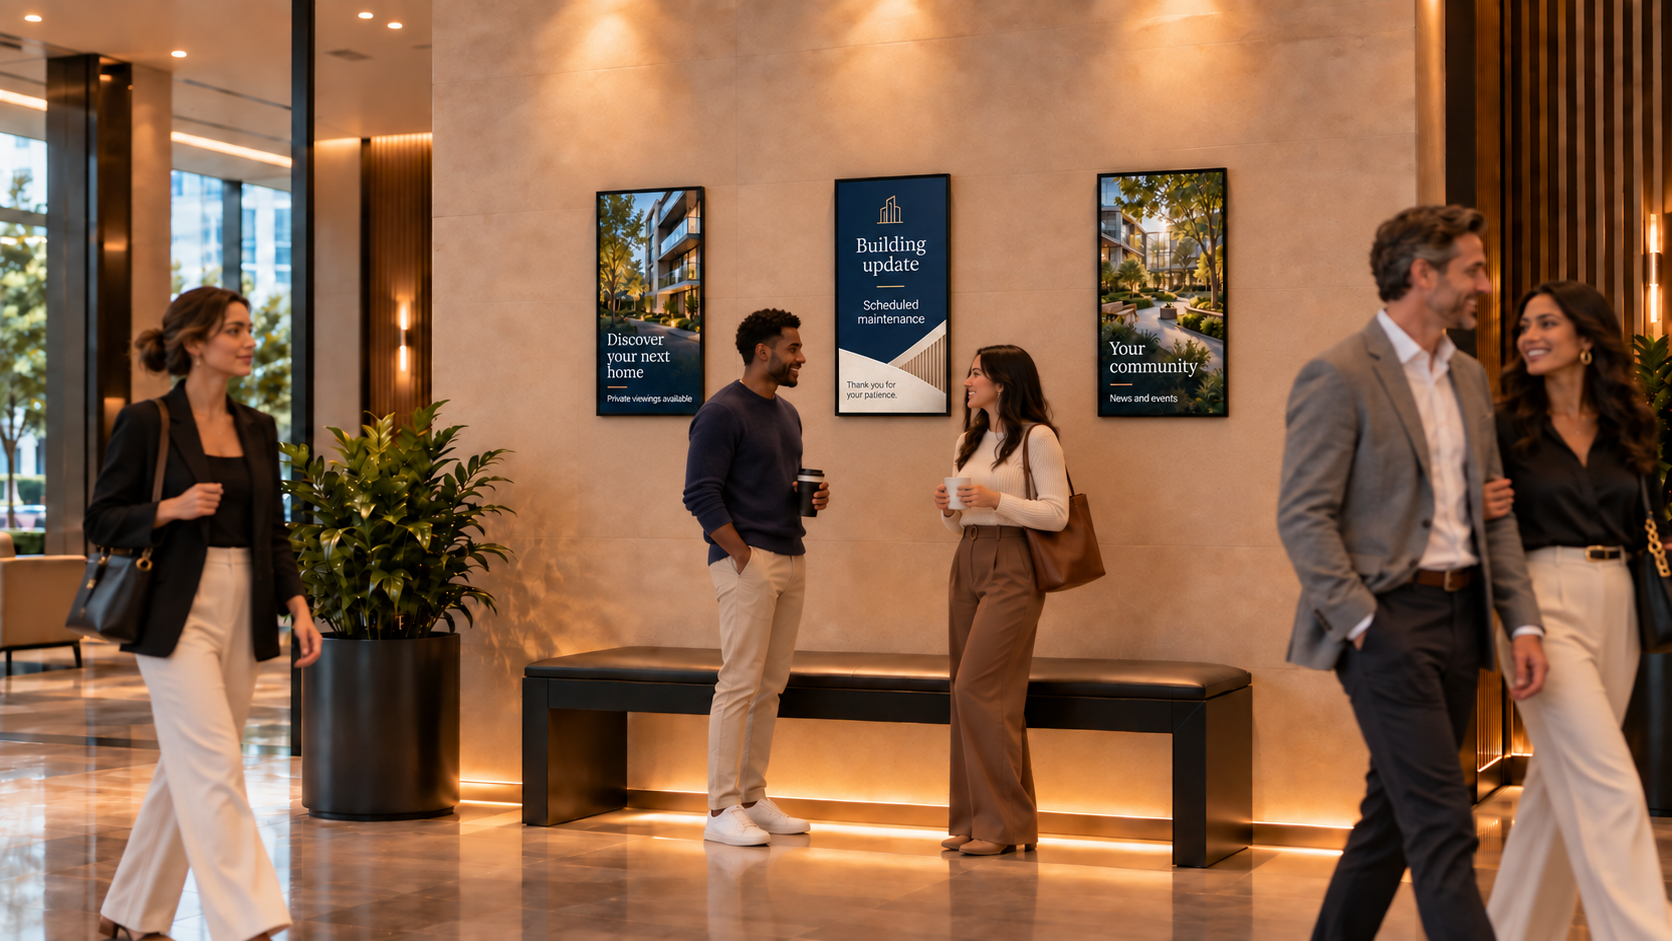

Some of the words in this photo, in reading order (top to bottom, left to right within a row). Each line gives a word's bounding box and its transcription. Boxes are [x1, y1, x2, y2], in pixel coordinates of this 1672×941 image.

[856, 236, 927, 256] Building
[863, 256, 919, 276] update
[863, 299, 919, 311] Scheduled
[857, 314, 925, 325] maintenance
[607, 333, 664, 346] Discover
[1109, 341, 1146, 356] Your
[607, 352, 637, 366] your
[641, 351, 670, 362] next
[607, 365, 644, 379] home
[1109, 358, 1198, 377] community
[847, 381, 869, 389] Thank
[870, 382, 884, 390] you
[886, 380, 895, 389] for
[607, 394, 631, 403] Private
[632, 394, 661, 404] viewings
[662, 394, 693, 403] available
[846, 391, 863, 400] your
[864, 391, 898, 400] patience.
[1109, 394, 1132, 403] News
[1134, 394, 1149, 403] and
[1151, 394, 1178, 403] events
